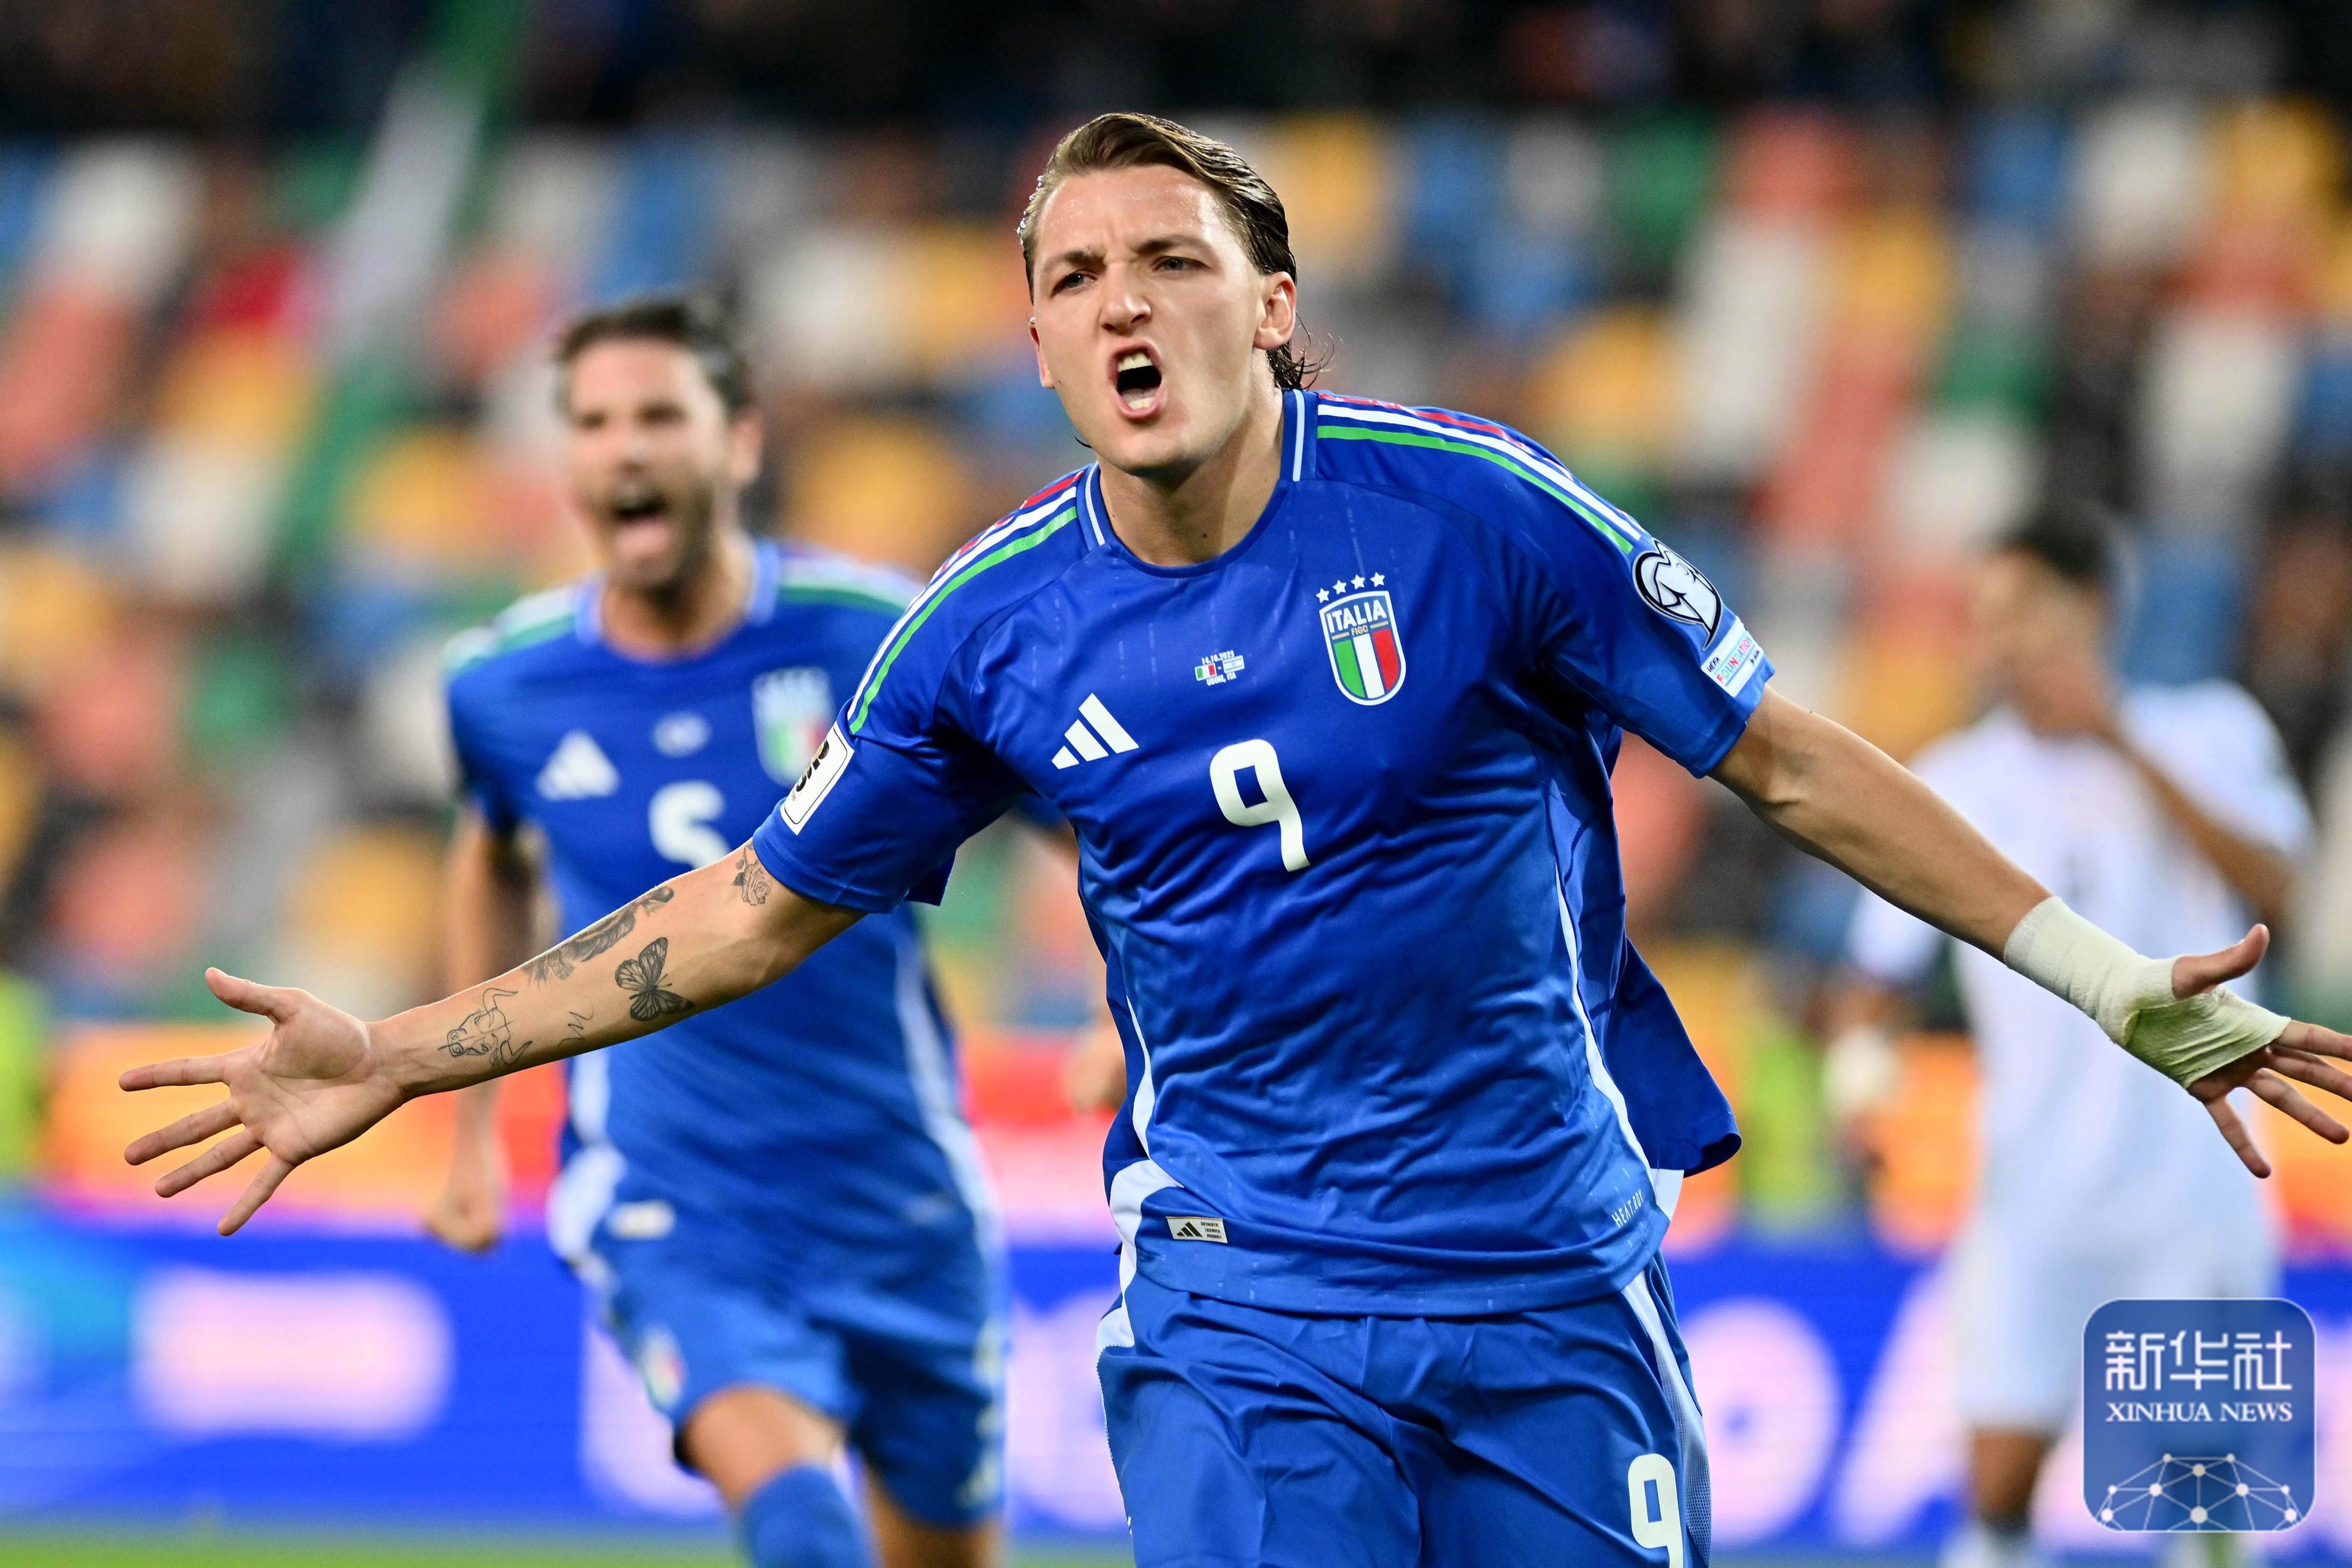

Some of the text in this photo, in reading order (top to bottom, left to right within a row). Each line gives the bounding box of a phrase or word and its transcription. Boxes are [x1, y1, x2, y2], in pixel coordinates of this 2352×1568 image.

[1326, 600, 1387, 633] ITALIA
[1351, 625, 1369, 636] FIGC
[1202, 650, 1235, 665] 14.10.2025
[1707, 657, 1720, 673] UEFA
[1227, 672, 1237, 681] ITA
[1210, 739, 1310, 872] 9
[1628, 1453, 1683, 1568] 9
